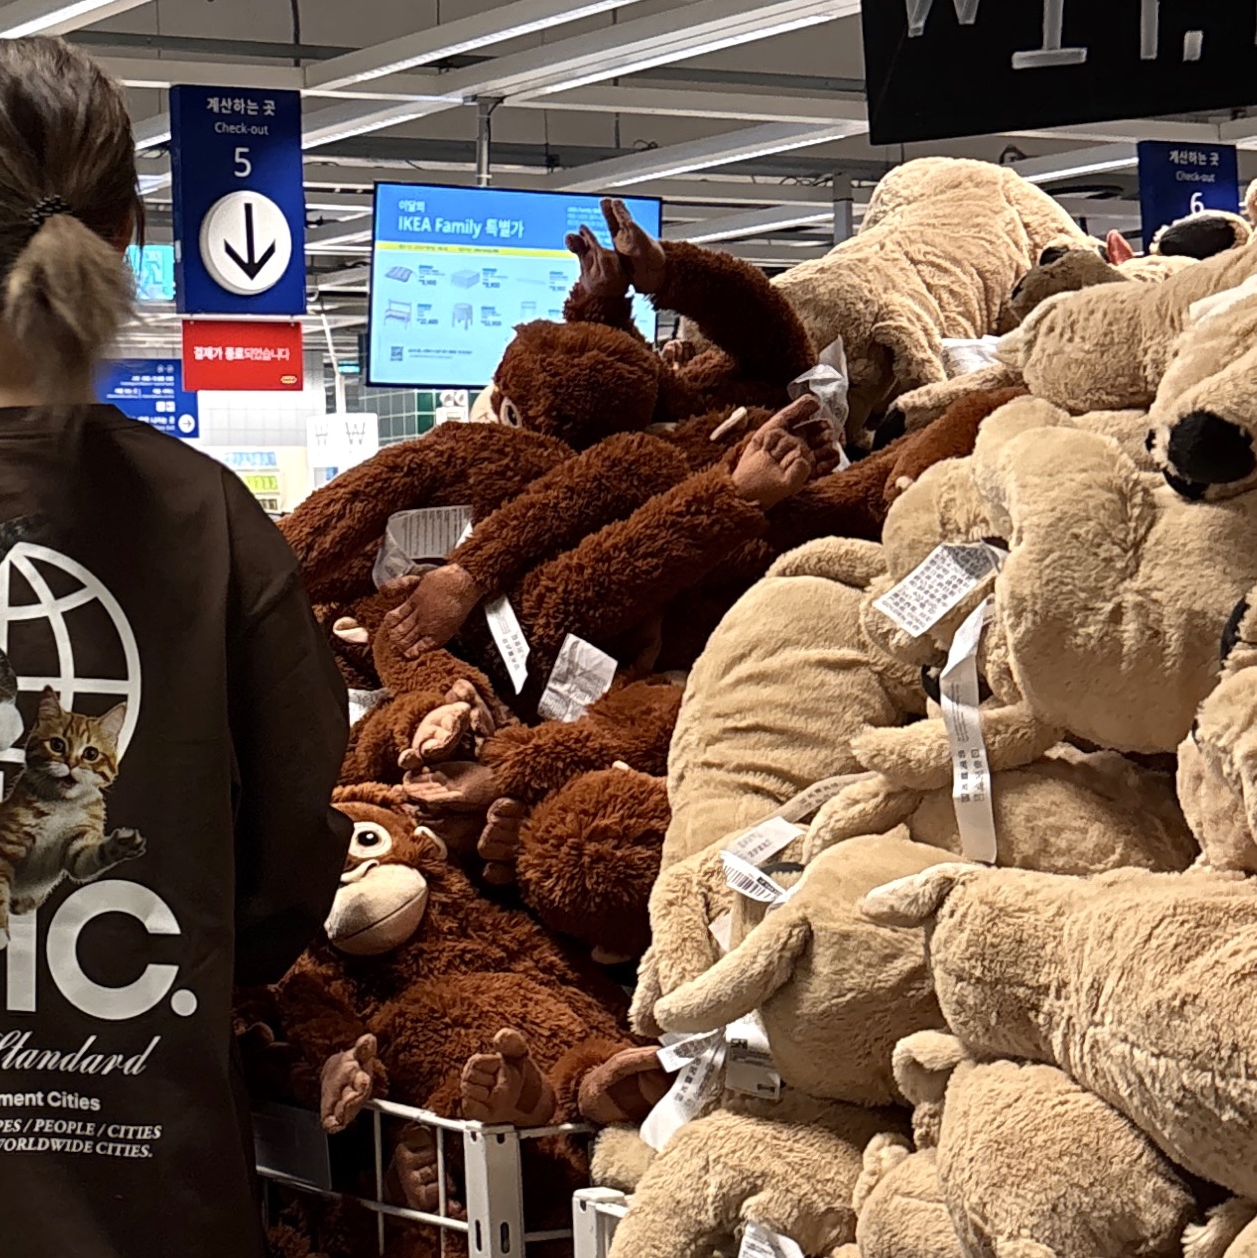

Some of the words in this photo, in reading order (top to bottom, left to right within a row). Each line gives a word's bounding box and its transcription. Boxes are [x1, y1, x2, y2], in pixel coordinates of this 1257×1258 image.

[206, 97, 259, 116] 계산하는
[263, 99, 276, 116] 곳
[214, 121, 269, 136] Check-out
[234, 147, 252, 178] 5
[1169, 150, 1207, 166] 계산하는
[1210, 152, 1219, 166] 곳
[1190, 192, 1204, 214] 6
[398, 215, 432, 232] IKEA
[435, 217, 482, 239] Family
[485, 218, 524, 239] 특별가
[193, 346, 223, 361] 결제가
[225, 346, 290, 361] 종료되었습니다
[47, 1091, 101, 1111] Cities
[33, 1118, 95, 1136] PEOPLE
[107, 1124, 162, 1139] CITIES
[95, 1141, 154, 1158] CITIES.
